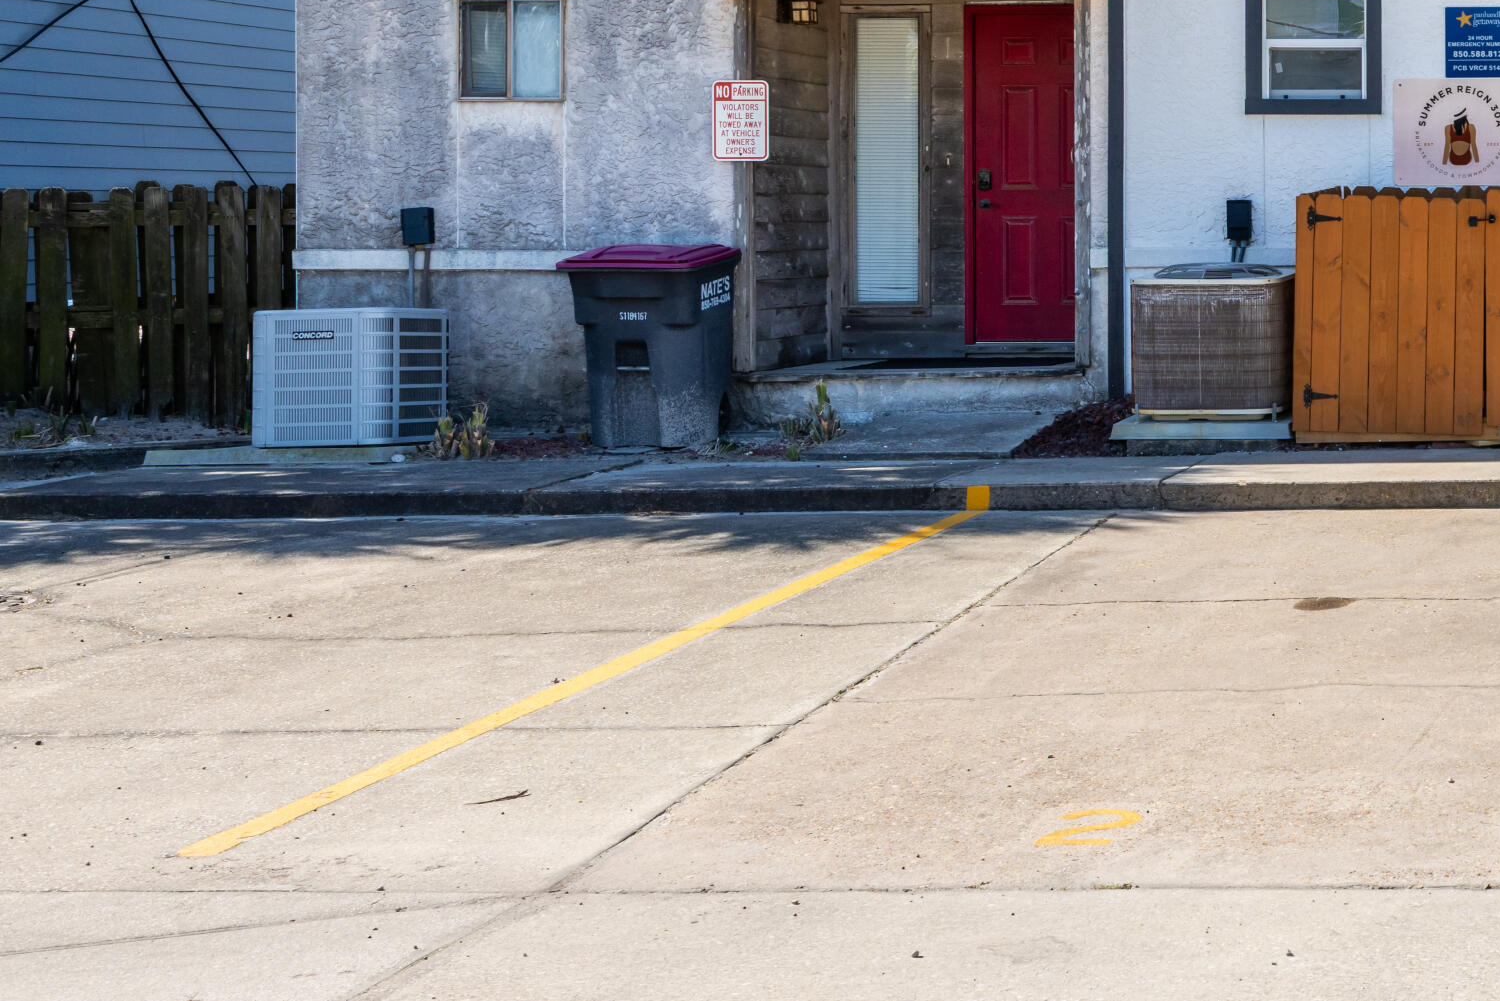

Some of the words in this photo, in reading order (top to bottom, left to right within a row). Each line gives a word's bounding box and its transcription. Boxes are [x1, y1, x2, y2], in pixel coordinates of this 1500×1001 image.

[716, 85, 730, 99] NO
[733, 87, 764, 97] PARKING
[722, 103, 759, 111] VIOLATORS
[1418, 87, 1453, 127] SUMMER
[1457, 85, 1492, 104] REIGN
[727, 112, 743, 120] WILL
[745, 112, 754, 120] BE
[726, 138, 755, 146] OWNER'S
[701, 275, 730, 300] NATE'S
[293, 331, 334, 339] CONCORD
[1033, 808, 1143, 847] 2
